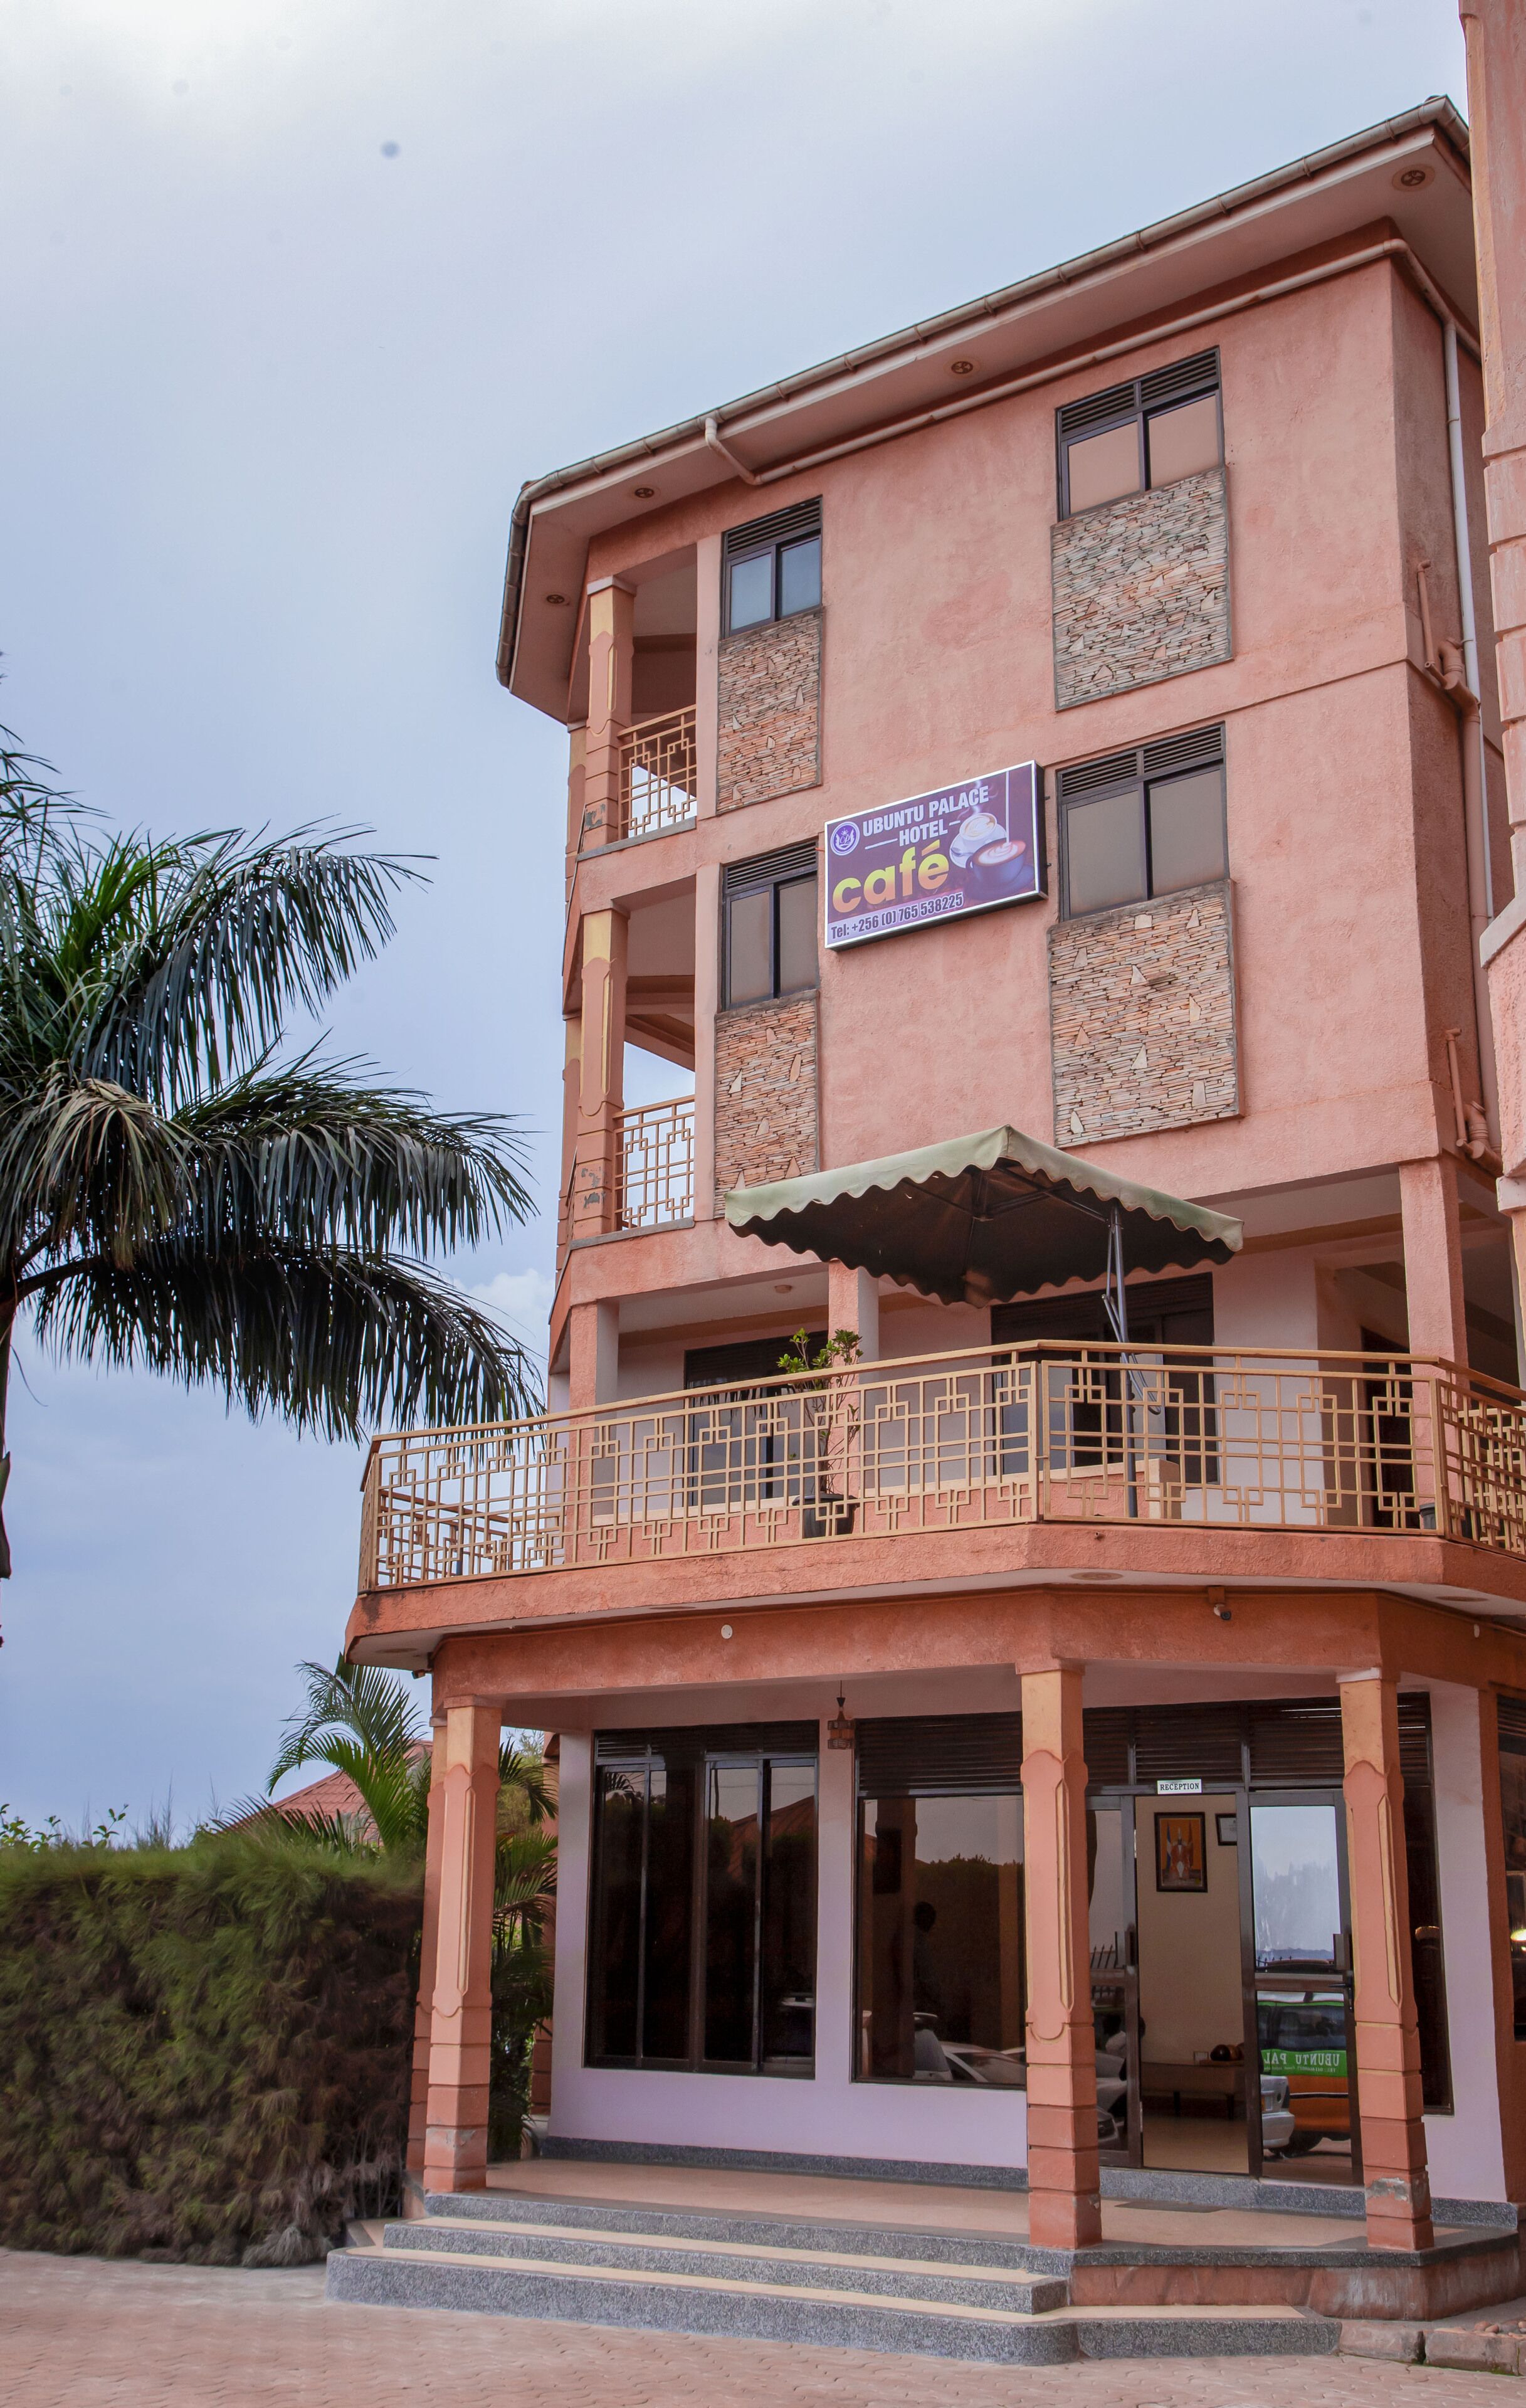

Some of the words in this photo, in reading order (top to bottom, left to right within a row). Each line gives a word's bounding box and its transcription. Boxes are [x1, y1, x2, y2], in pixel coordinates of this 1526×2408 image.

[862, 804, 924, 837] UBUNTU
[929, 785, 989, 818] PALACE
[899, 819, 948, 847] HOTEL
[832, 840, 949, 913] café
[831, 924, 850, 939] Tel:
[851, 915, 879, 932] +256
[881, 911, 896, 926] (0)
[898, 904, 918, 921] 765
[920, 892, 963, 916] 538225
[1160, 1783, 1199, 1791] RECEPTION
